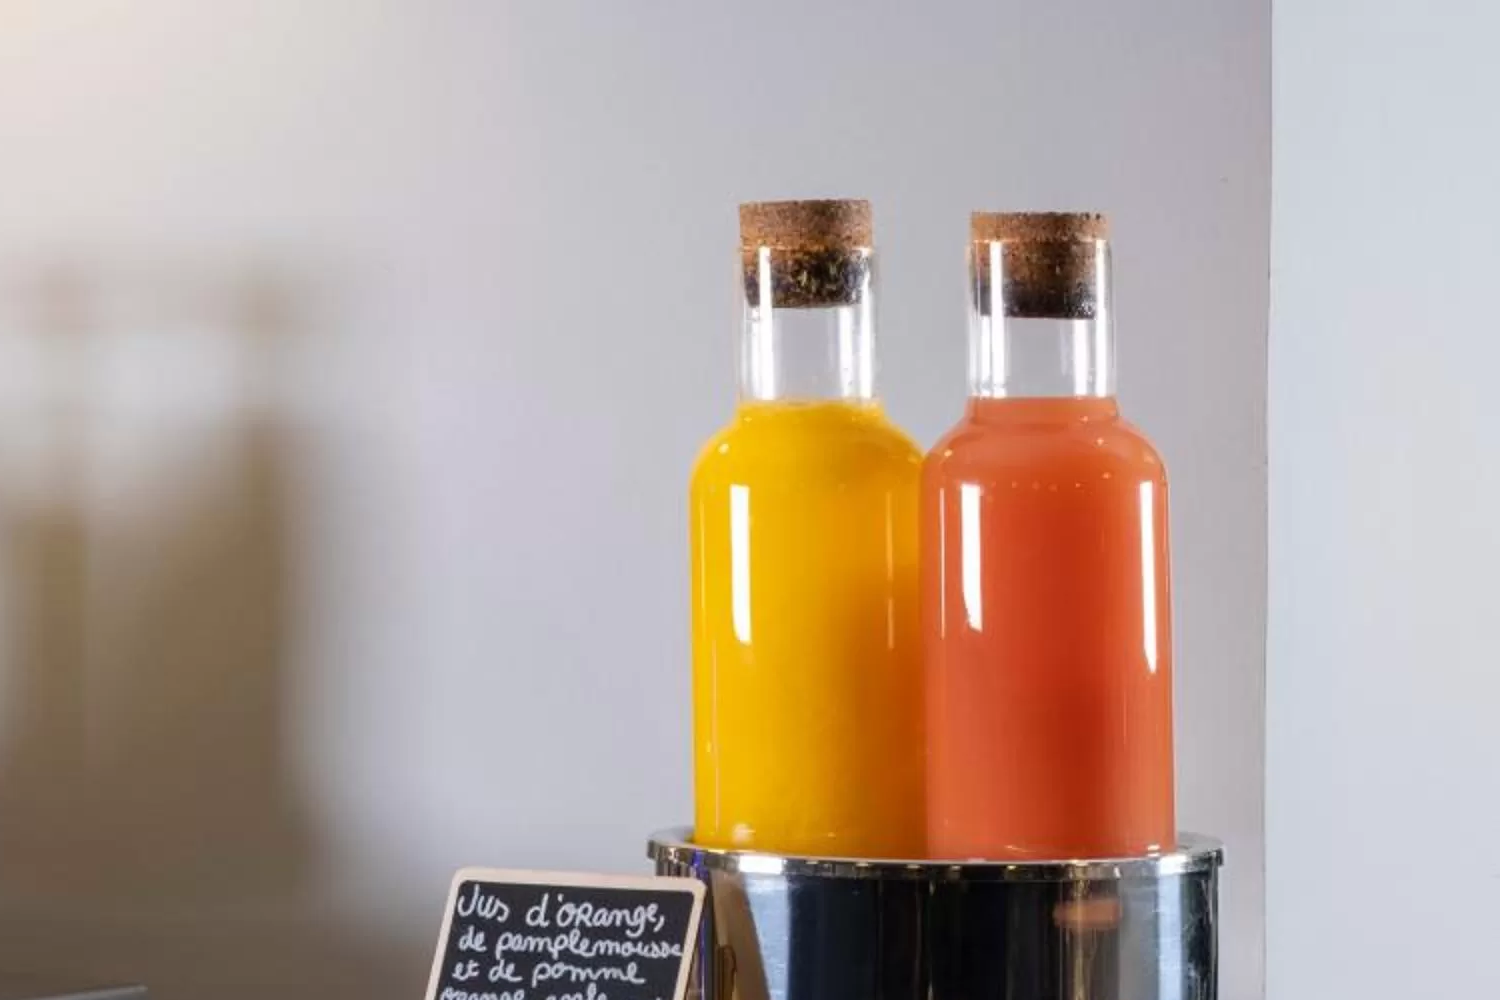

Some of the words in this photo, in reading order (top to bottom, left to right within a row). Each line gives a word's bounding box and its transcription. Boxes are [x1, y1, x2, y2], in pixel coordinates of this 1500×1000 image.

[457, 884, 510, 923] Jus
[458, 926, 487, 952] de
[452, 959, 480, 981] et
[488, 960, 524, 982] de
[531, 961, 647, 988] pomme
